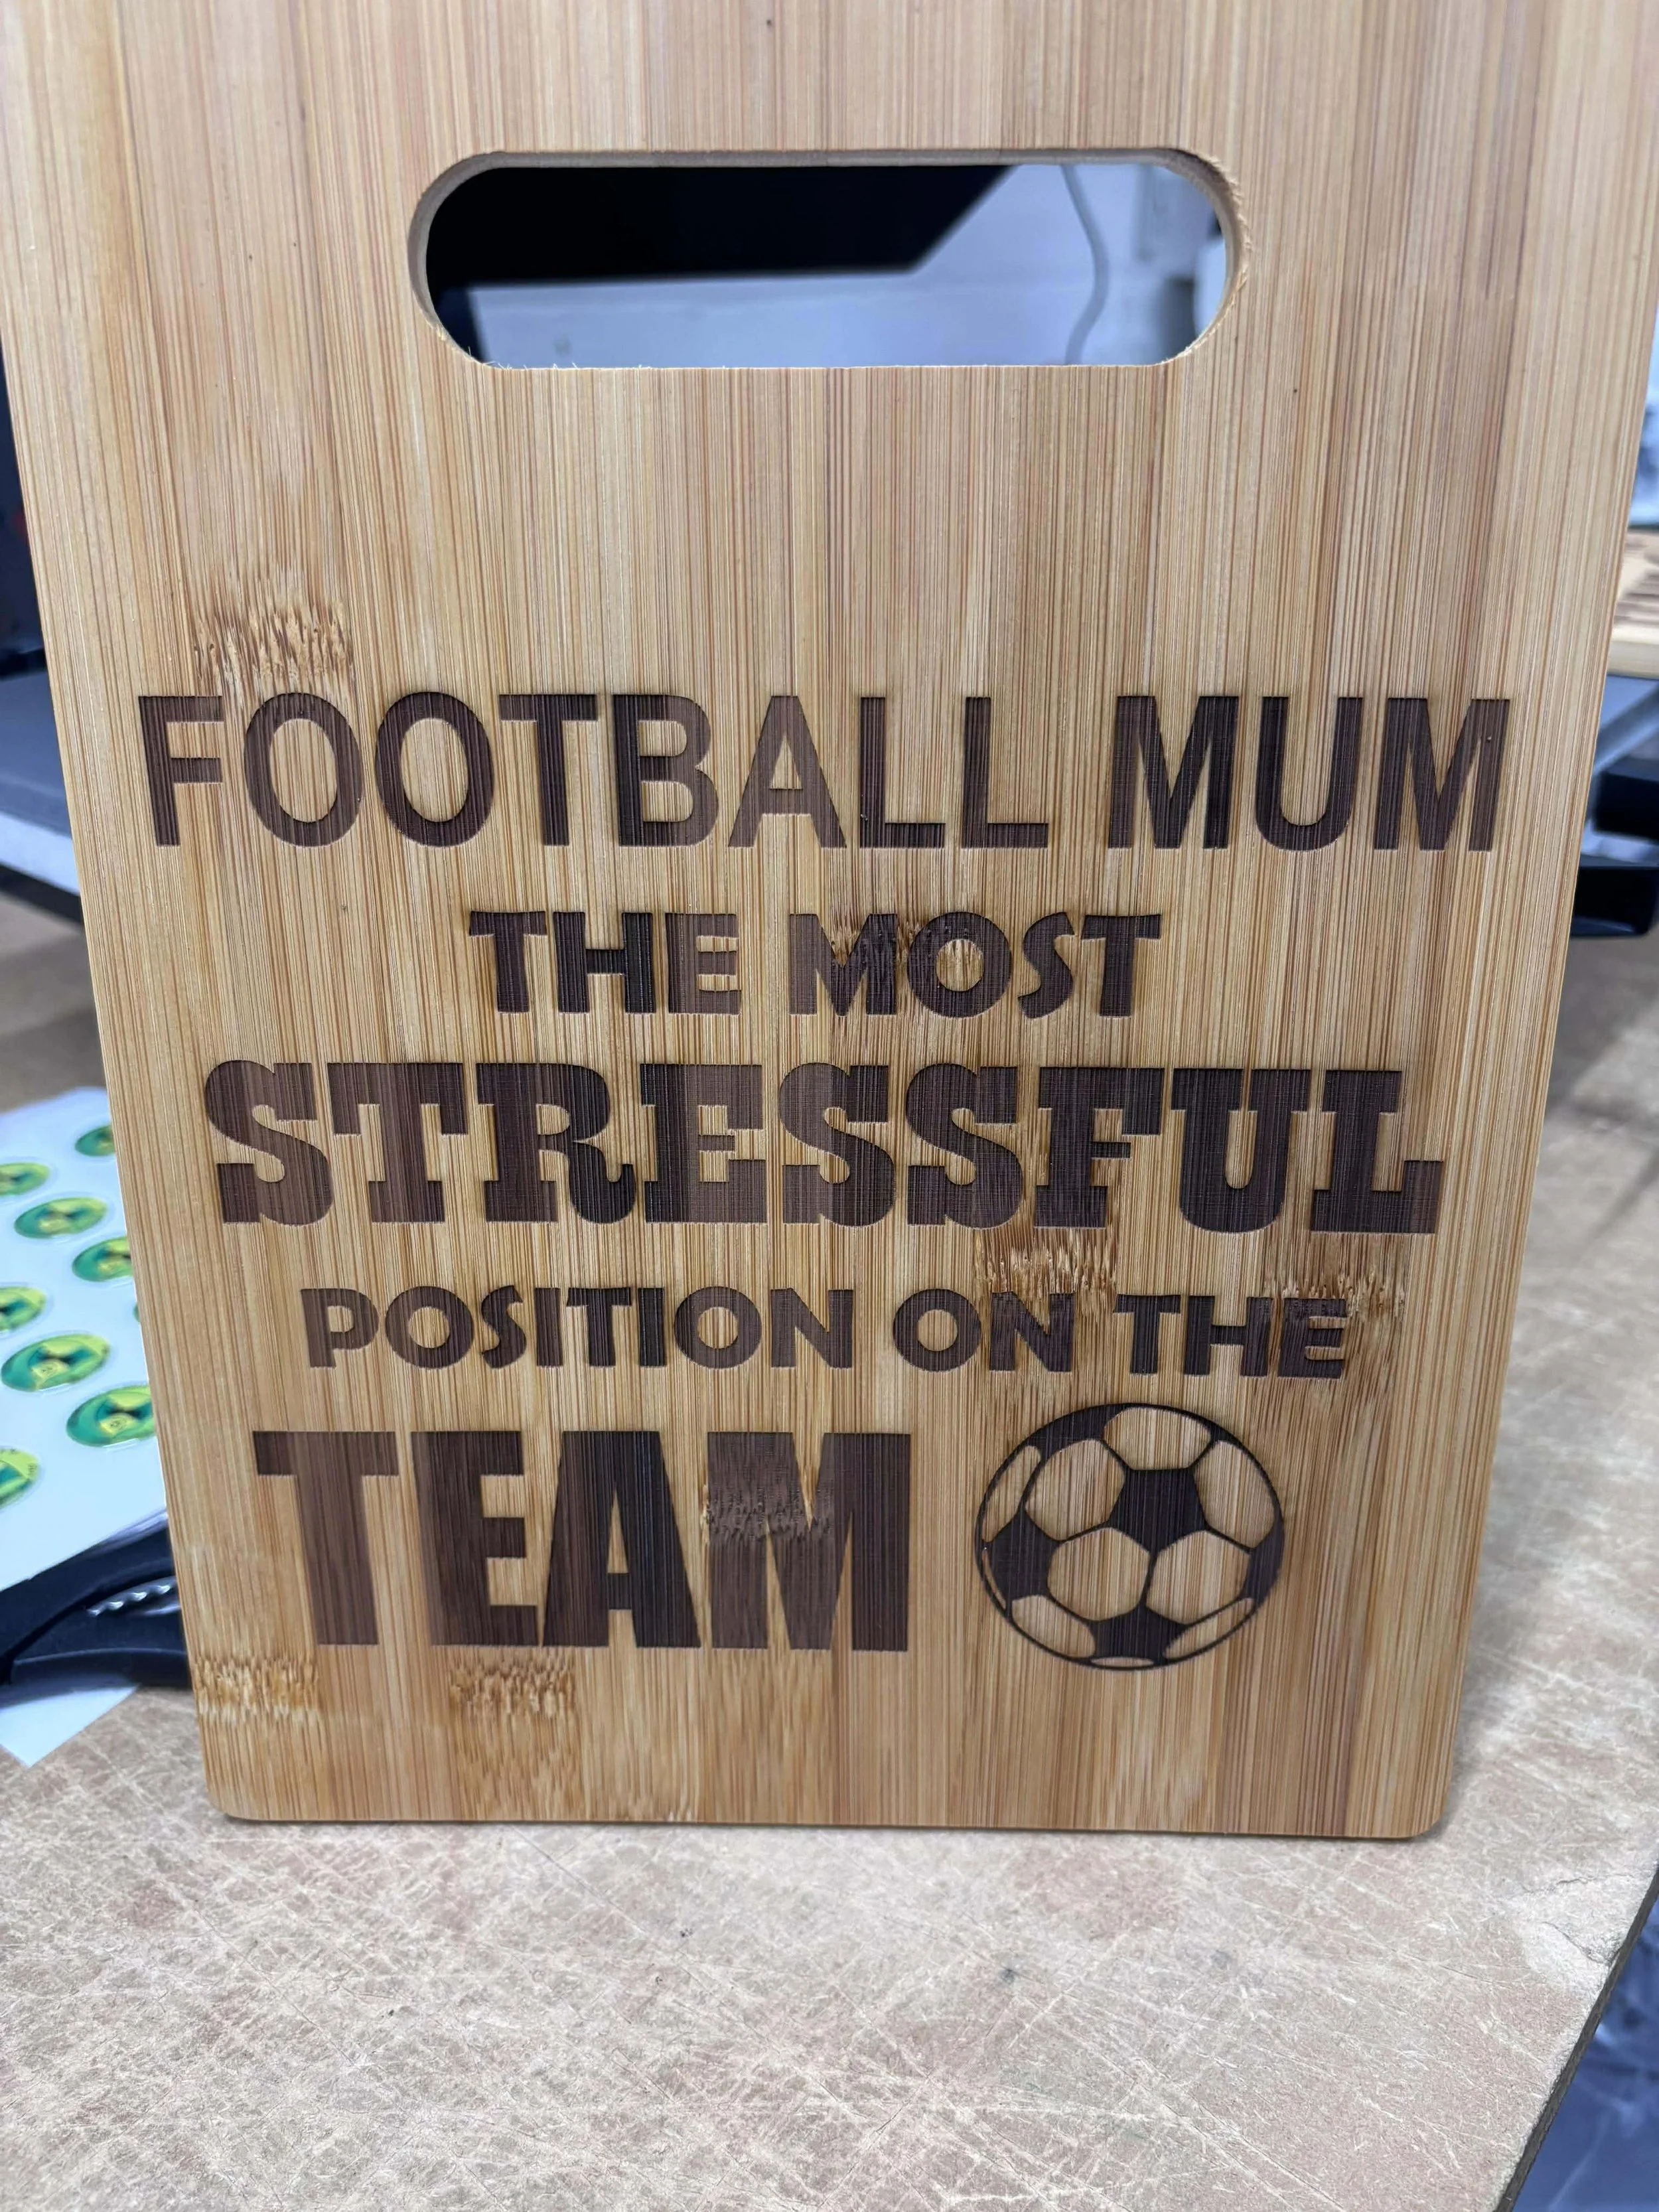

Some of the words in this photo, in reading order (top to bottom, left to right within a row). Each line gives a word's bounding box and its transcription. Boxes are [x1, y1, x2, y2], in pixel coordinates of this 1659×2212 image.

[138, 691, 1049, 848] FOOTBALL
[1108, 695, 1510, 850] MUM
[469, 911, 741, 1013] THE
[790, 913, 1160, 1019] MOST
[204, 1060, 1443, 1235] STRESSFUL
[301, 1286, 855, 1368] POSITION
[892, 1288, 1074, 1373] ON
[1114, 1293, 1344, 1379] THE
[253, 1431, 910, 1651] TEAM
